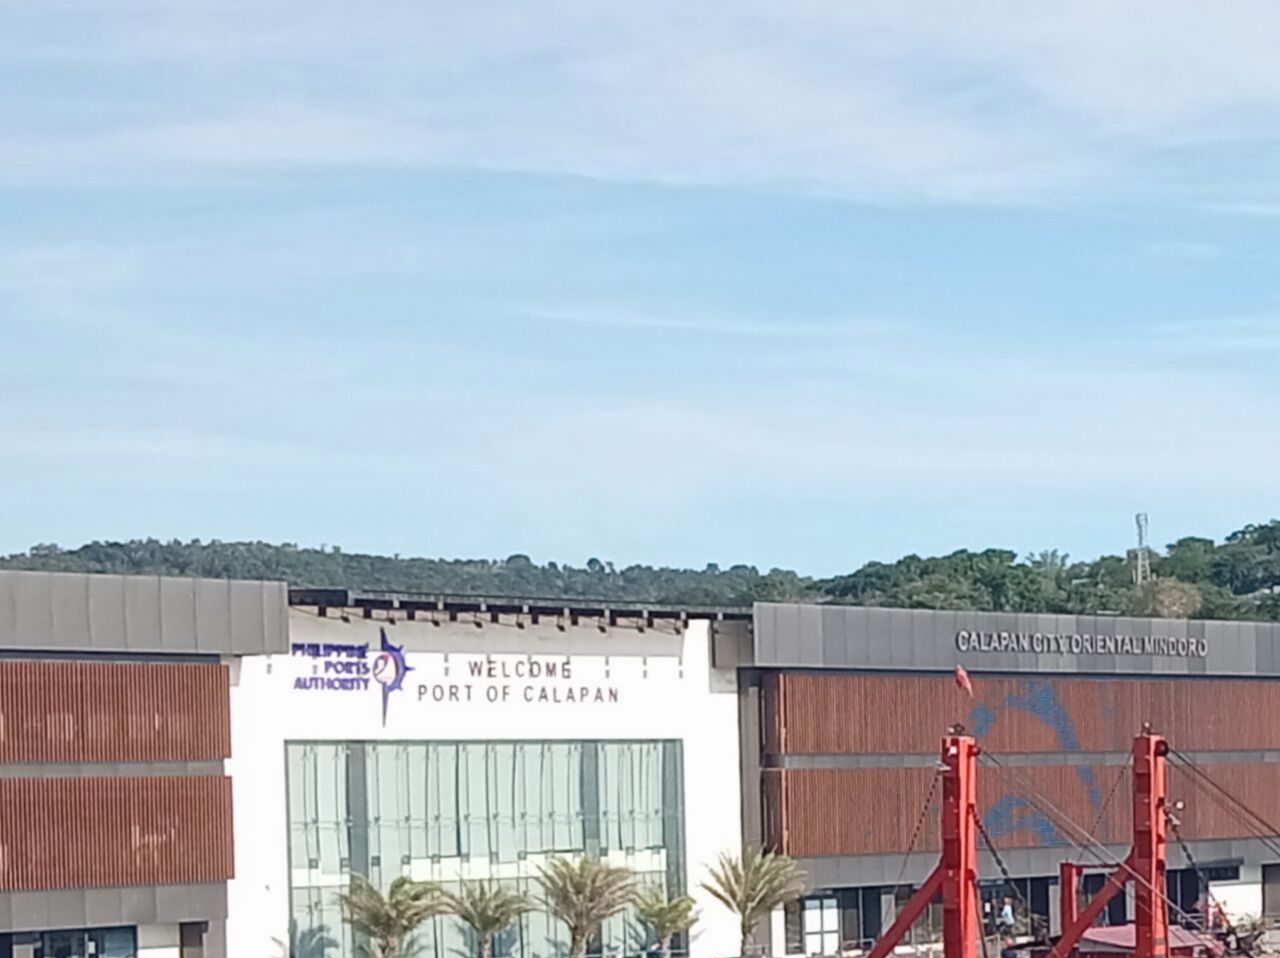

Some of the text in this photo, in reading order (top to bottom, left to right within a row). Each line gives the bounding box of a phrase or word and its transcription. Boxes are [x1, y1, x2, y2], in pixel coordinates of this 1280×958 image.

[291, 643, 369, 659] PHILIPPINE
[957, 630, 1032, 652] CALAPAN
[1071, 634, 1142, 655] ORIENTAL
[1144, 636, 1209, 658] MINDORO
[324, 661, 370, 675] PORTS
[468, 660, 572, 679] WELCOME
[293, 677, 370, 690] AUTHORITY
[417, 684, 619, 704] PORT OF CALAPAN
